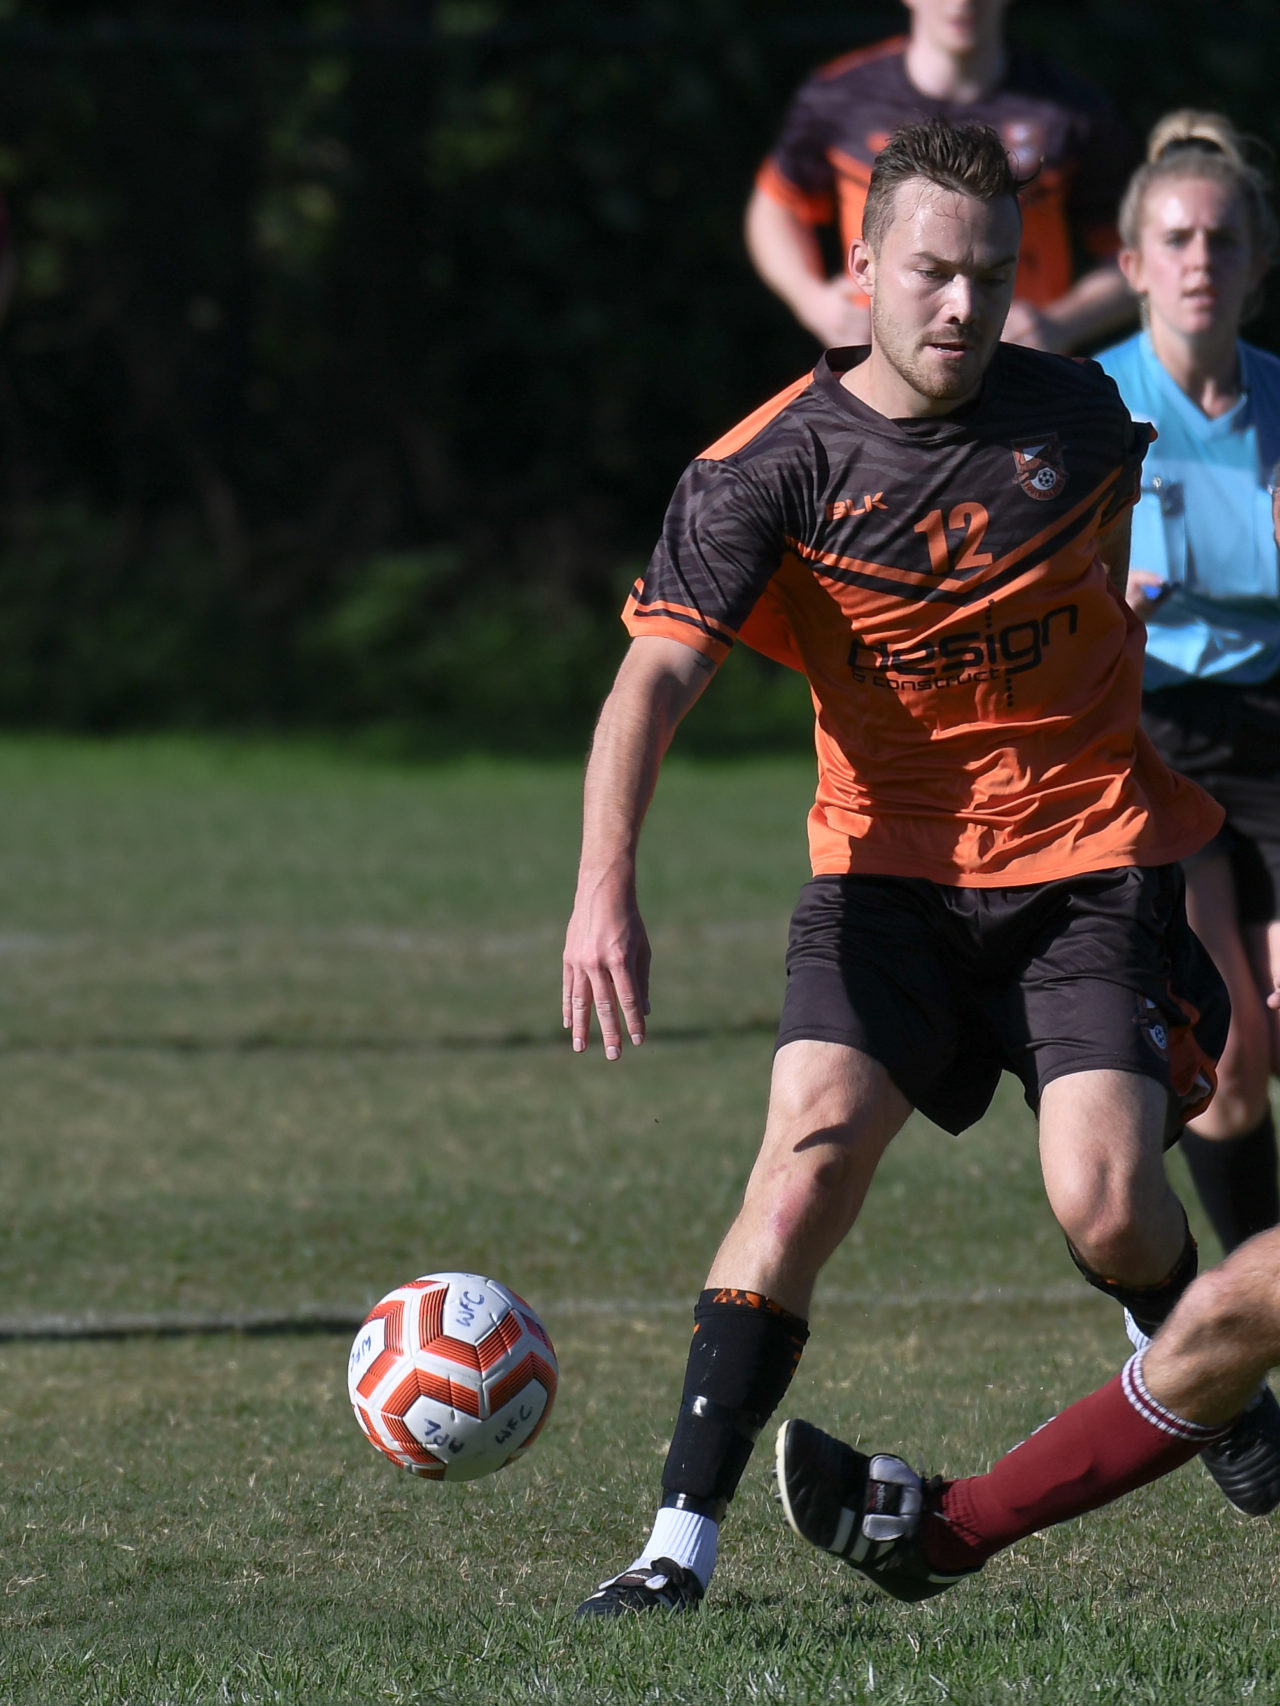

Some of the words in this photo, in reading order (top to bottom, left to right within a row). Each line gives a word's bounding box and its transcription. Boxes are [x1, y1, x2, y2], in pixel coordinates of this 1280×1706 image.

[826, 491, 889, 521] BLK
[913, 502, 993, 575] 12
[847, 600, 1079, 676] design
[872, 666, 1001, 691] construct
[456, 1290, 485, 1328] WFC
[495, 1404, 533, 1445] WFC
